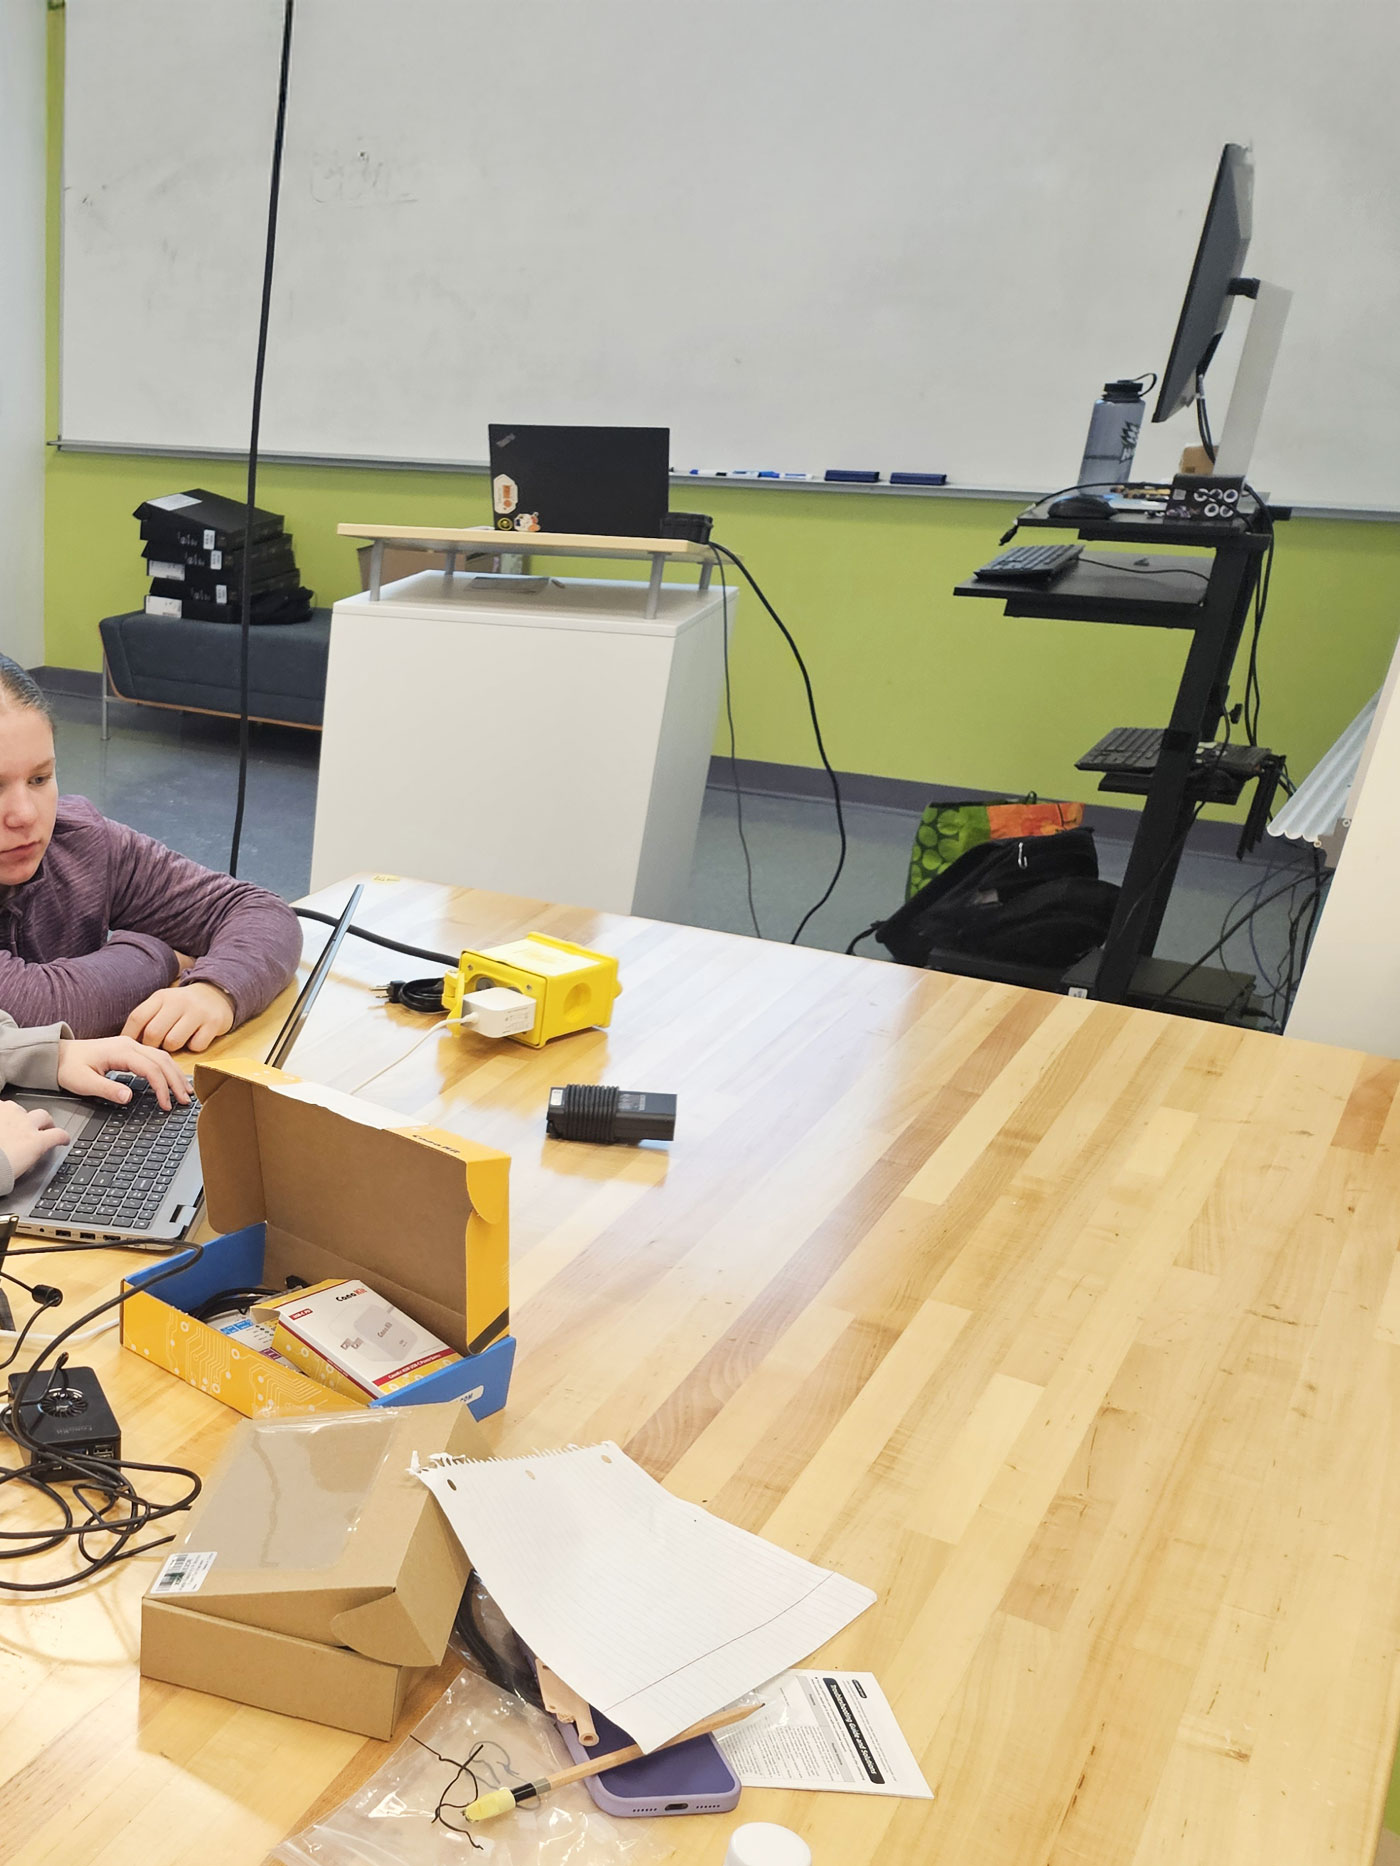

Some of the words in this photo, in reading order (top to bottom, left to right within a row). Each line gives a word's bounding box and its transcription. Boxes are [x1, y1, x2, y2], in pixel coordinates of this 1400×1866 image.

[828, 1684, 853, 1722] Troubleshooting
[847, 1723, 860, 1737] Guide
[854, 1738, 866, 1749] and
[859, 1749, 878, 1774] Solutions
